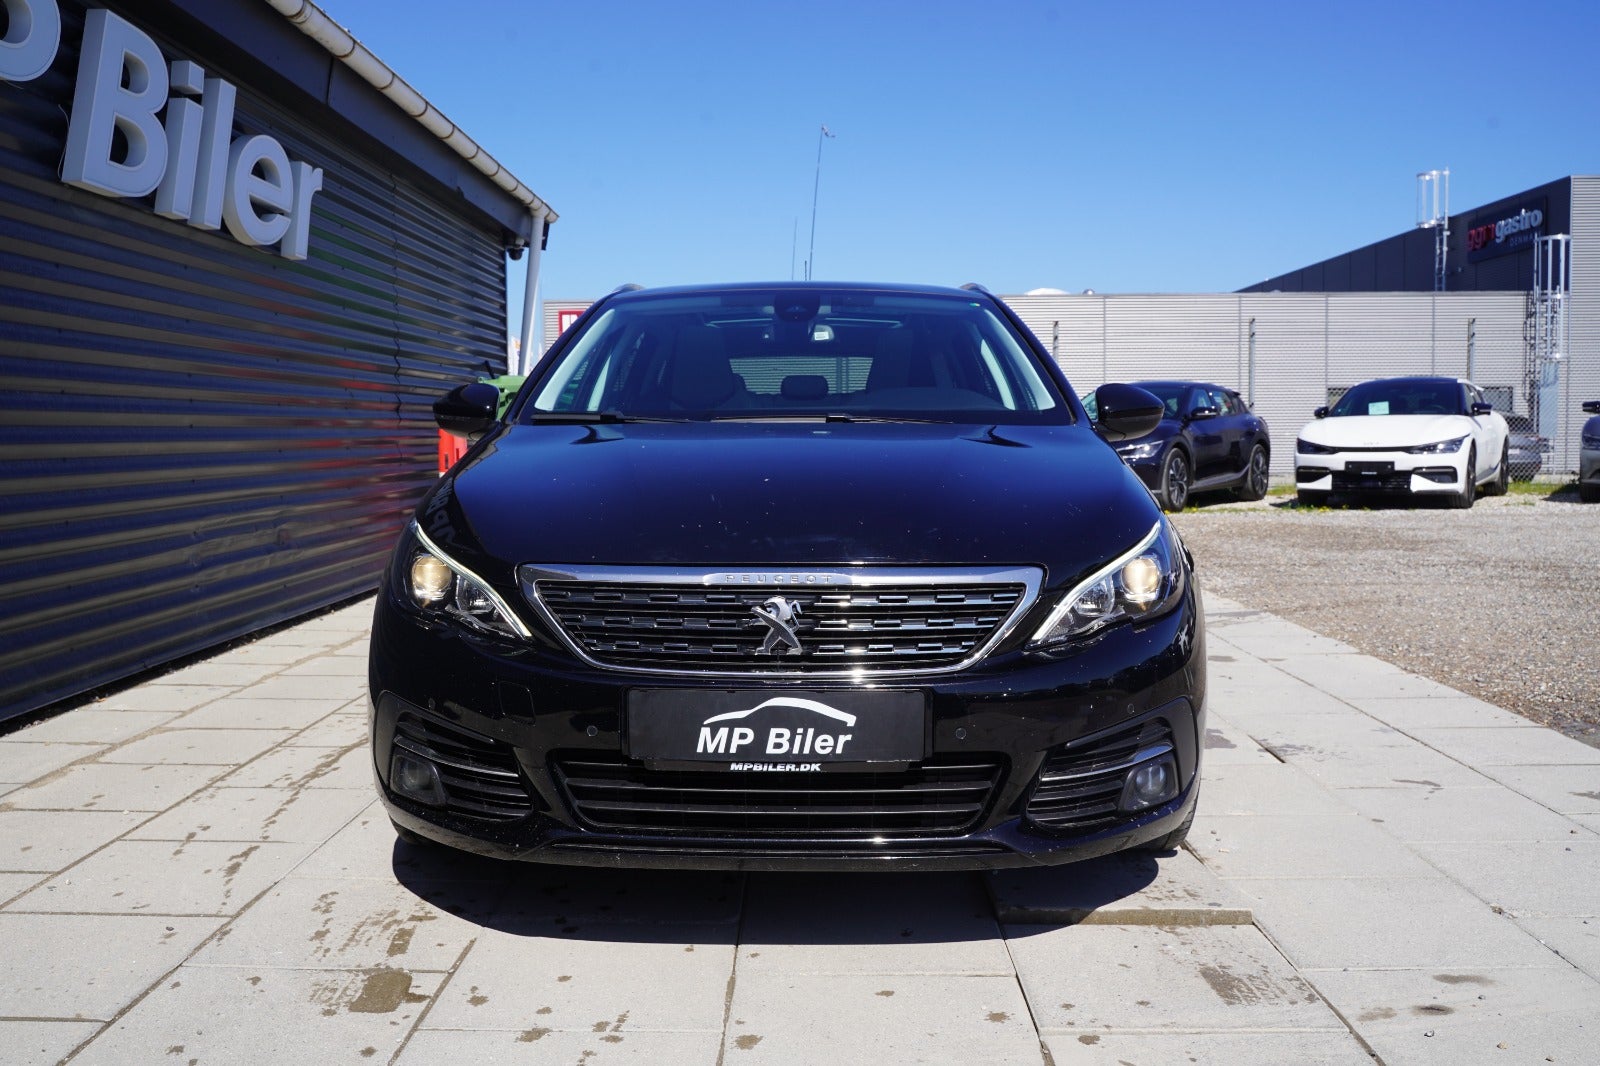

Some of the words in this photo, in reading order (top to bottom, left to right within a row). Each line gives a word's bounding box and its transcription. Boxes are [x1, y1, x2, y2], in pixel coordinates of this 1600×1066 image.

[62, 9, 323, 260] Biler
[725, 574, 832, 584] PEUGEOT
[697, 727, 755, 754] MP
[766, 728, 852, 755] Biler
[730, 762, 822, 772] MPBILER.DK
